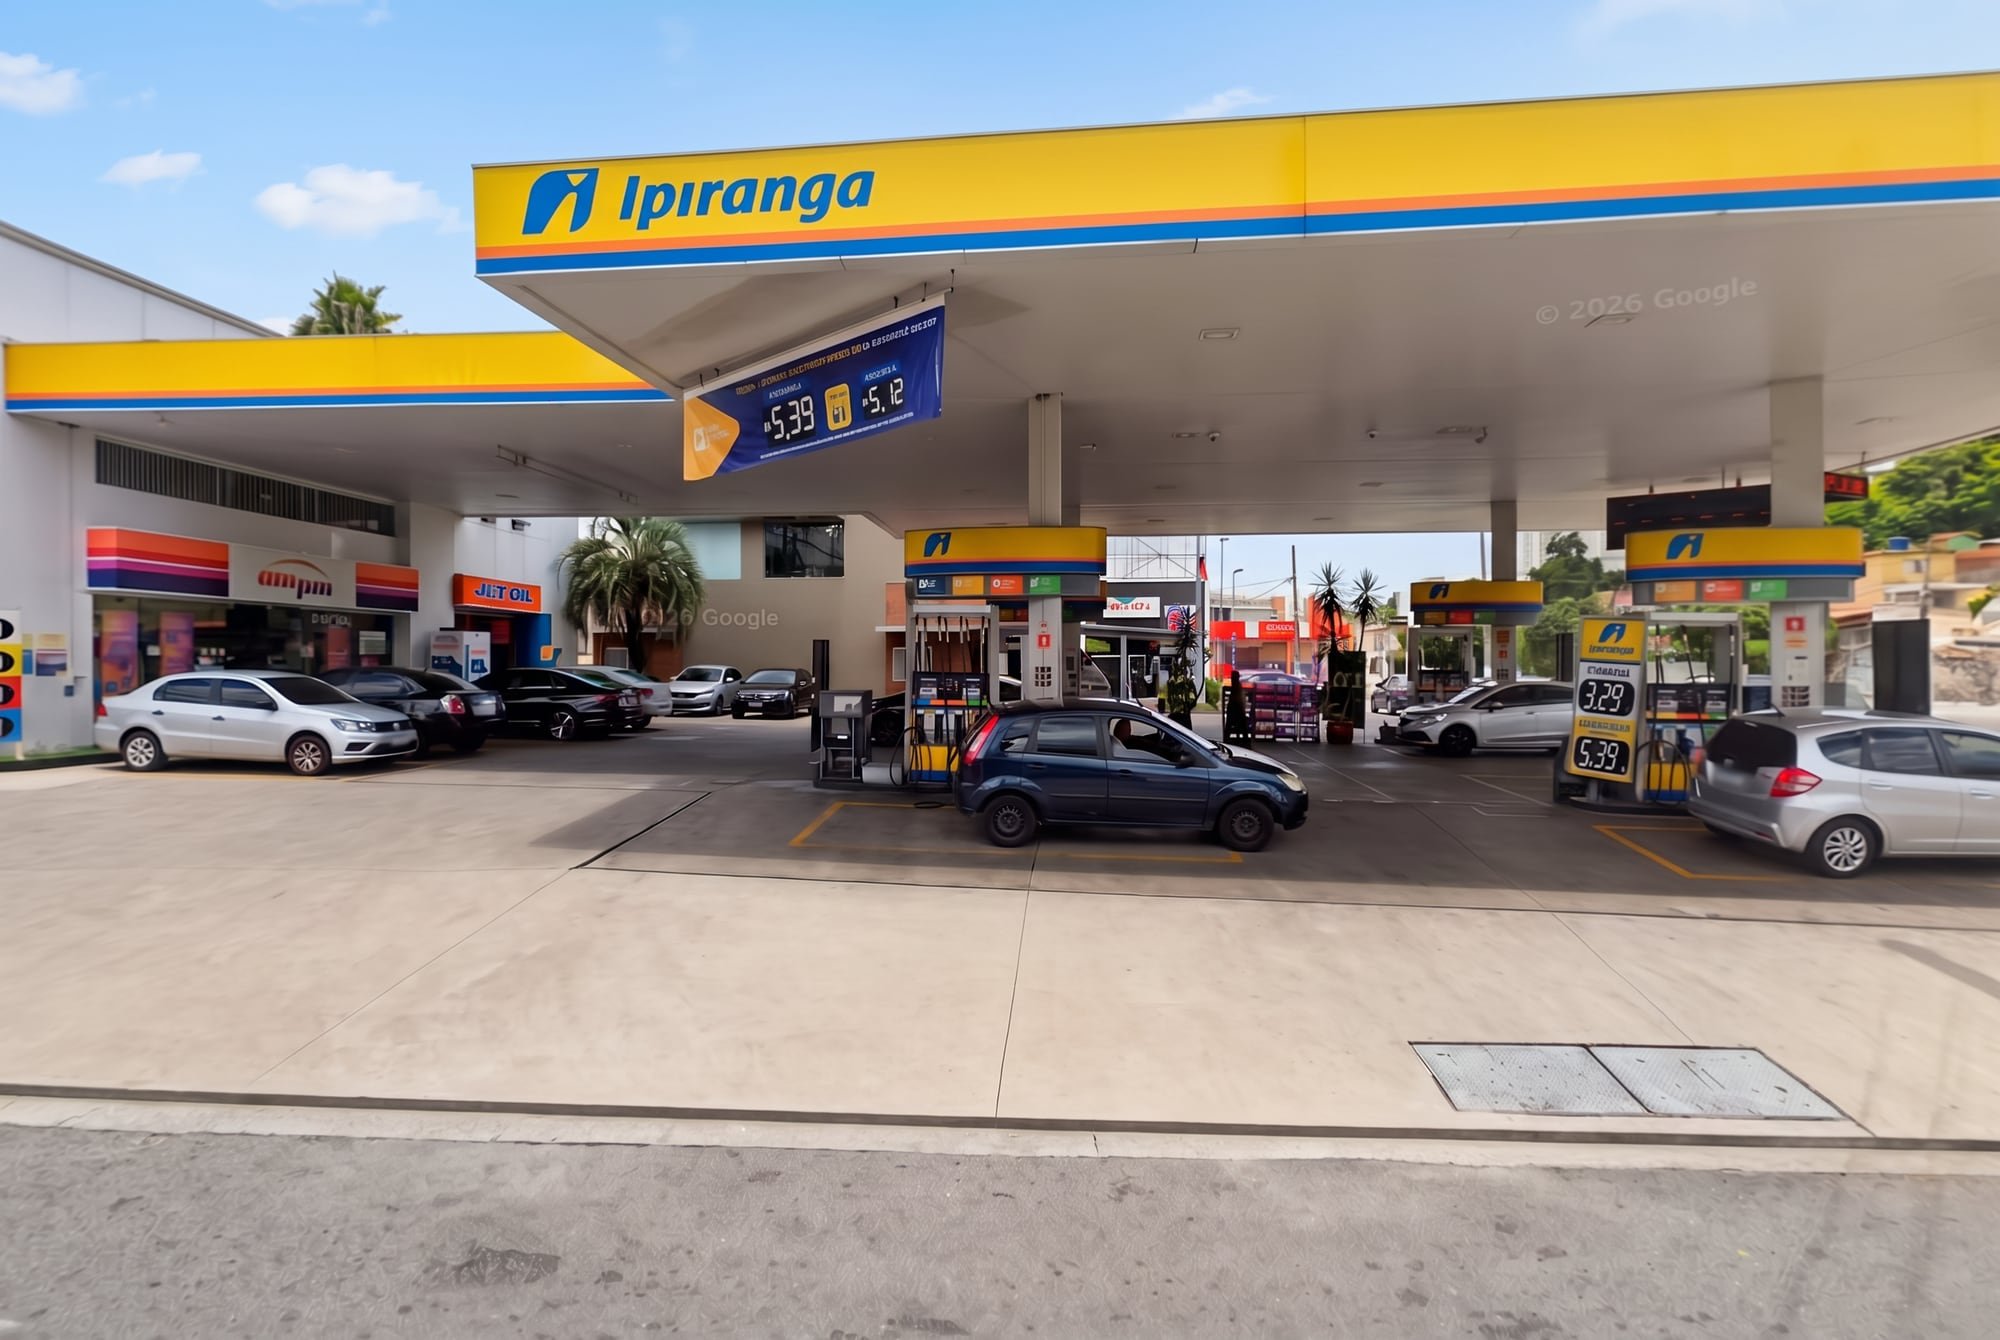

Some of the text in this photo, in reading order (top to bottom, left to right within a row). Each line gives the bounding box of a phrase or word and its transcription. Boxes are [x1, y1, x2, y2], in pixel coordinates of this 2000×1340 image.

[619, 170, 875, 231] Ipiranga
[257, 570, 333, 600] ampm
[509, 588, 533, 603] OIL
